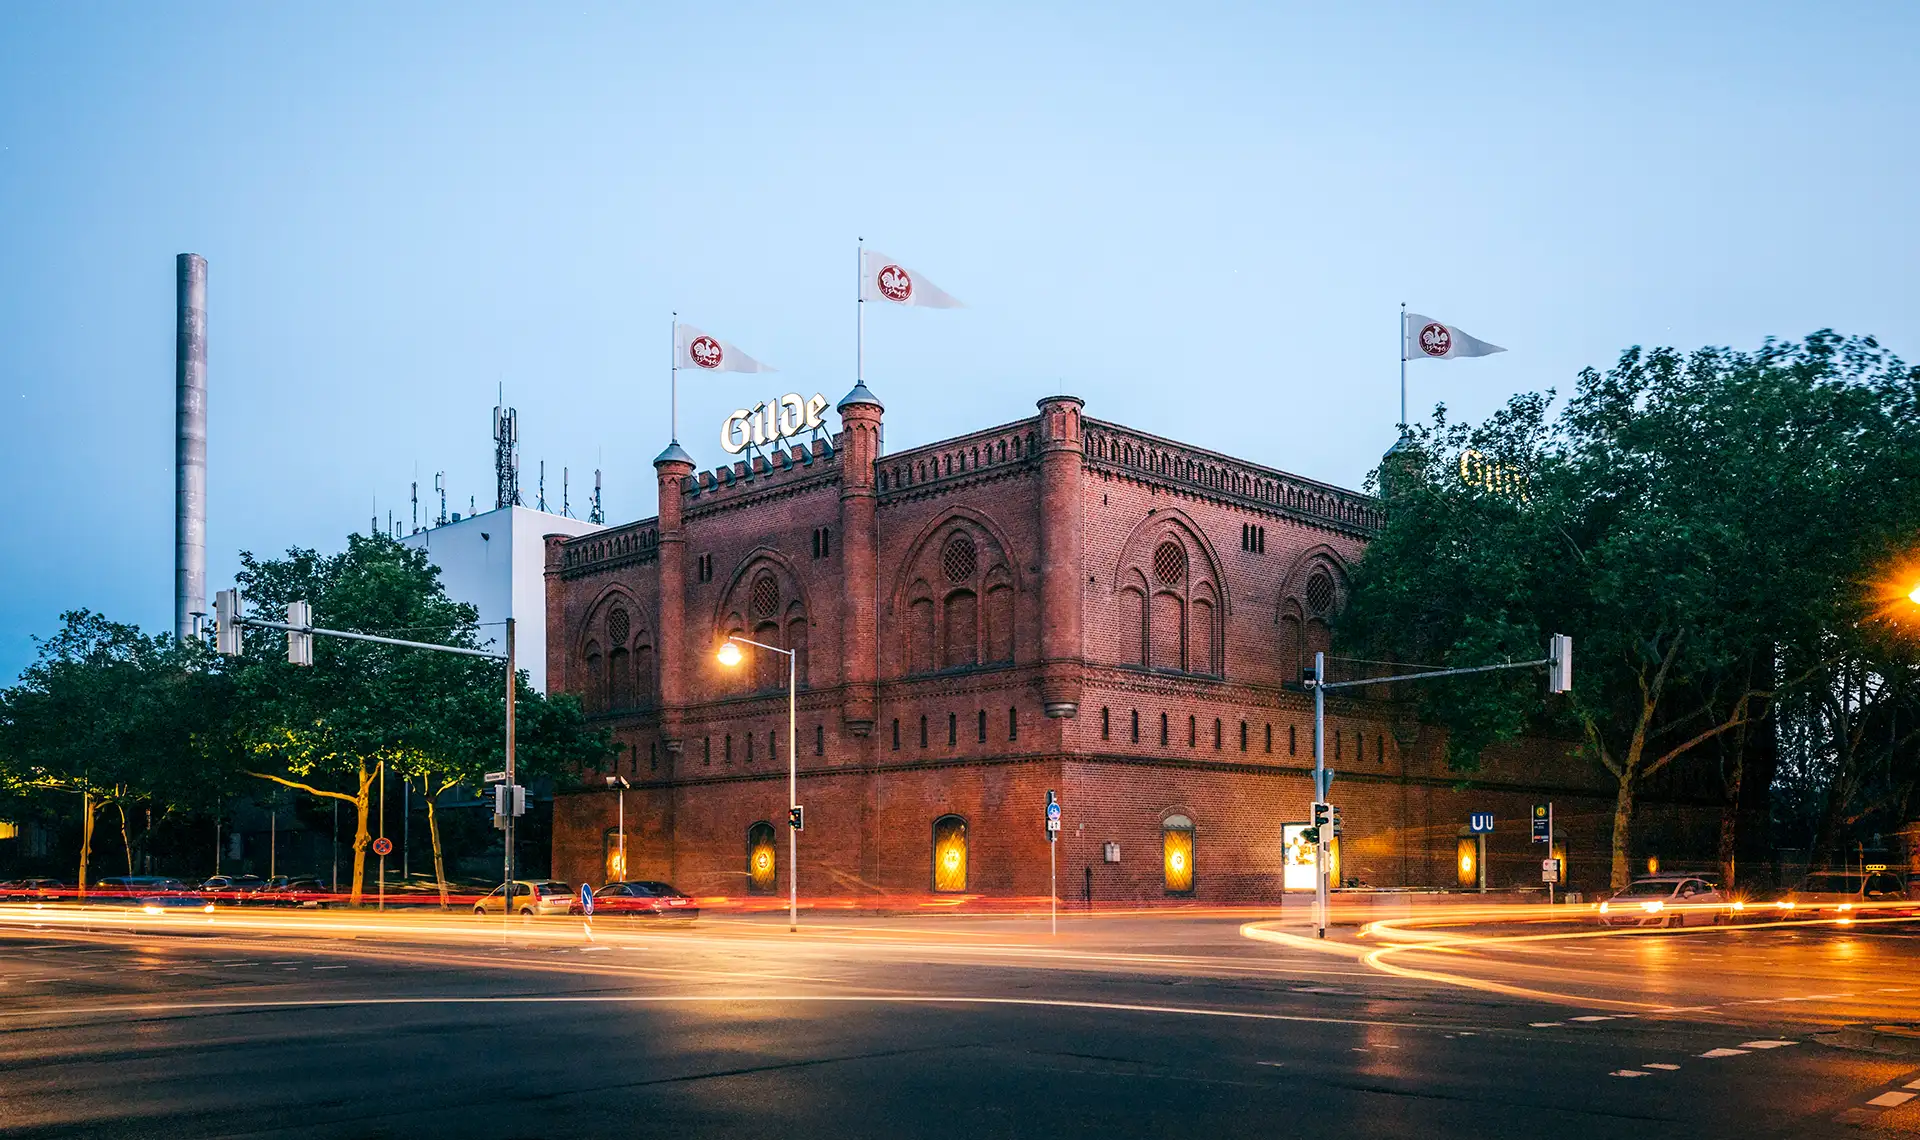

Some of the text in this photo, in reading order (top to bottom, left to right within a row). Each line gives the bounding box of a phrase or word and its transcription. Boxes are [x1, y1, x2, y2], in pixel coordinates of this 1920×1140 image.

[720, 392, 830, 455] Gilde
[1472, 815, 1484, 830] U
[1486, 815, 1494, 830] U
